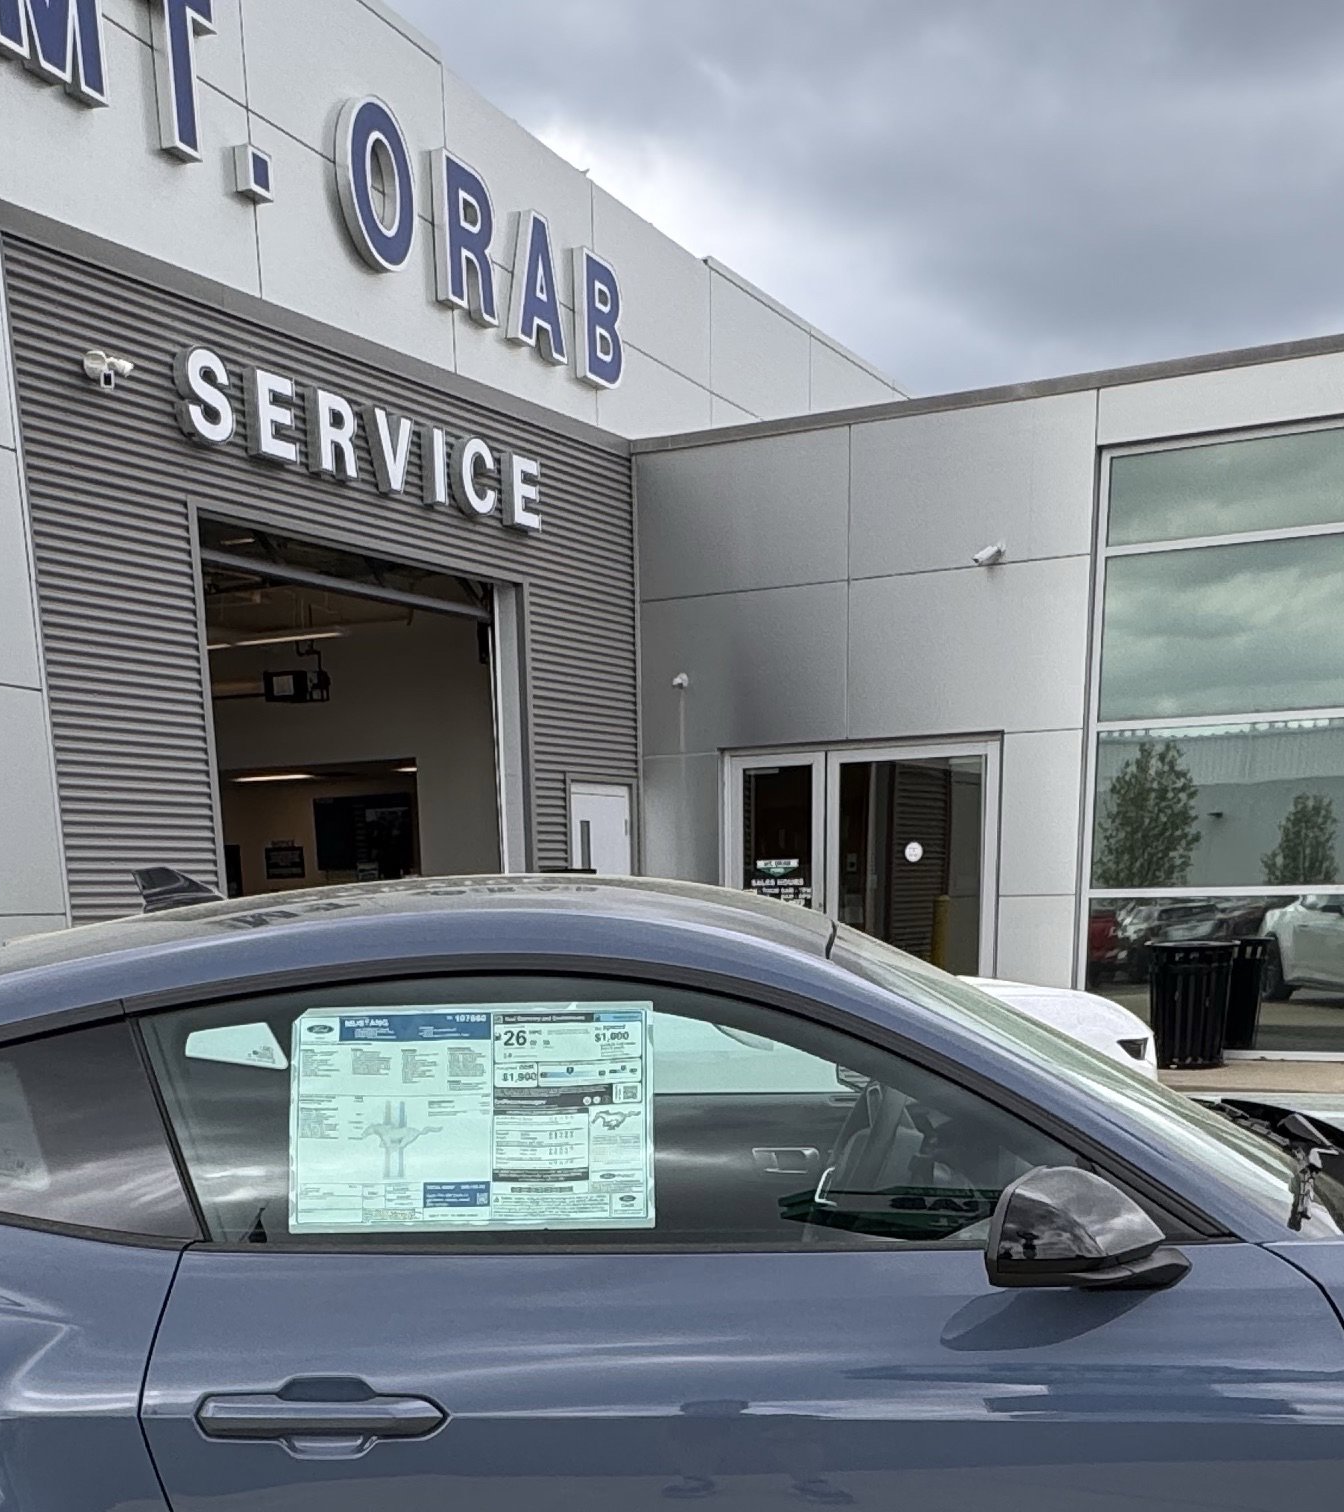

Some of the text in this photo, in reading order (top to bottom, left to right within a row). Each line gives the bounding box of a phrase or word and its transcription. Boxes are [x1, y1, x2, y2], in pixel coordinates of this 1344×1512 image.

[335, 94, 624, 391] ORAB
[173, 344, 543, 533] SERVICE
[503, 1029, 527, 1047] 26
